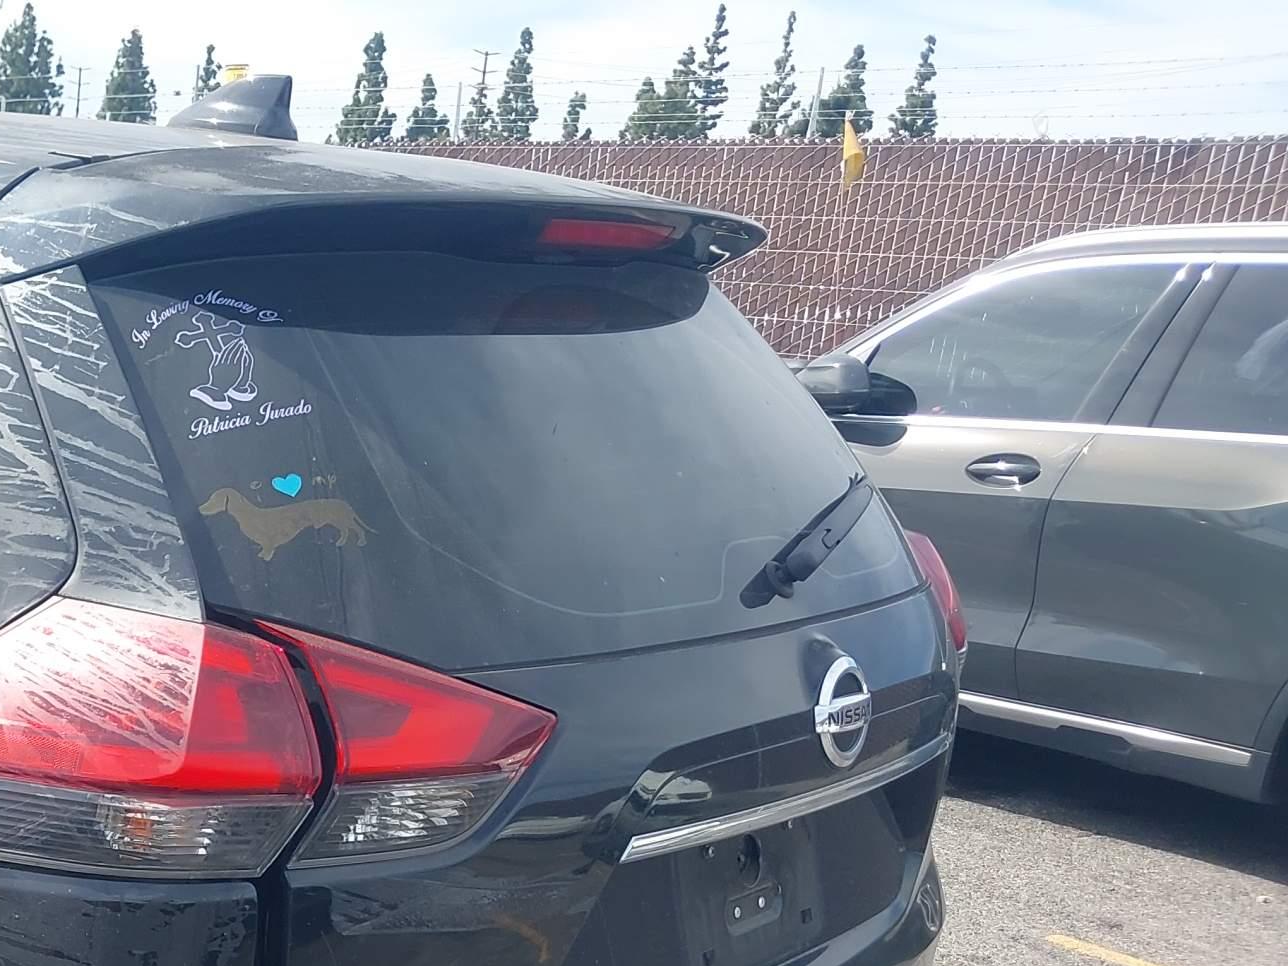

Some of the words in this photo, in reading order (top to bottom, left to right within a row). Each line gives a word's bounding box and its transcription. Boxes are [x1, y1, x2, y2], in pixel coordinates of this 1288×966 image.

[131, 328, 151, 349] In
[146, 300, 190, 330] Loving
[194, 289, 257, 314] Memory
[188, 413, 252, 439] Patricia
[256, 399, 312, 426] Jurado
